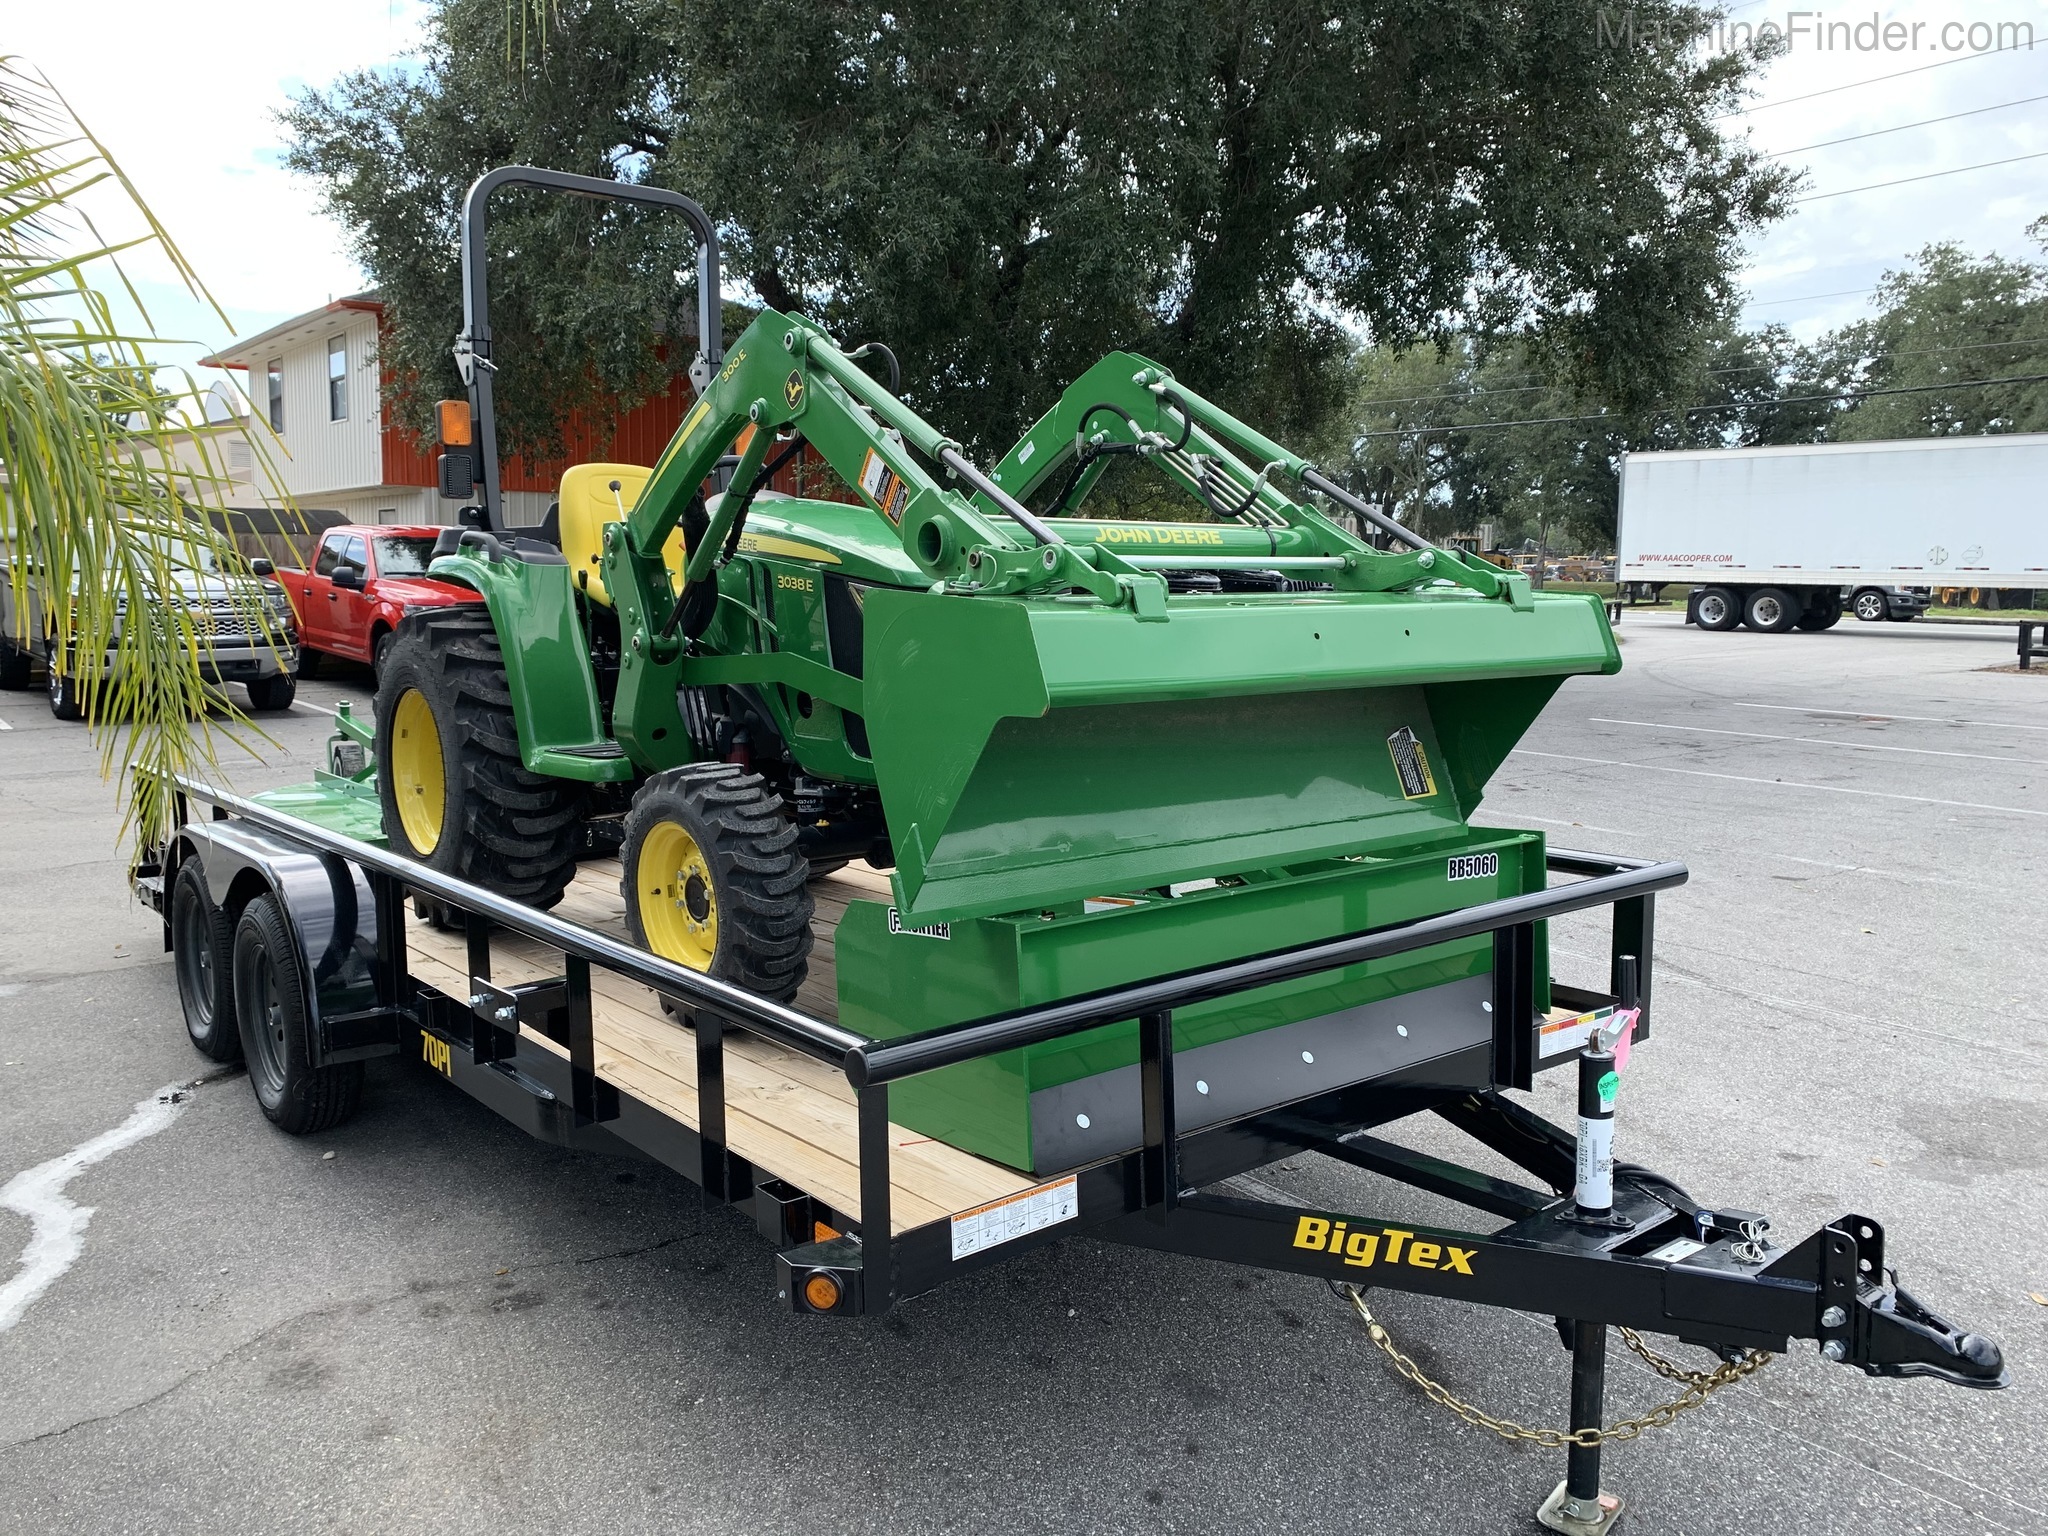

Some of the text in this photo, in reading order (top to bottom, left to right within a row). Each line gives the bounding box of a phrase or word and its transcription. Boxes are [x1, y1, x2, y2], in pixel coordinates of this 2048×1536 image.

[737, 537, 758, 551] EERE
[1095, 525, 1224, 545] JOHN DEERE
[1639, 554, 1733, 562] WWW.AAACOOPER.COM
[1418, 751, 1431, 779] CAUTION
[1448, 854, 1497, 879] BB5060
[420, 1029, 452, 1078] 70PI
[1292, 1215, 1479, 1276] BigTex
